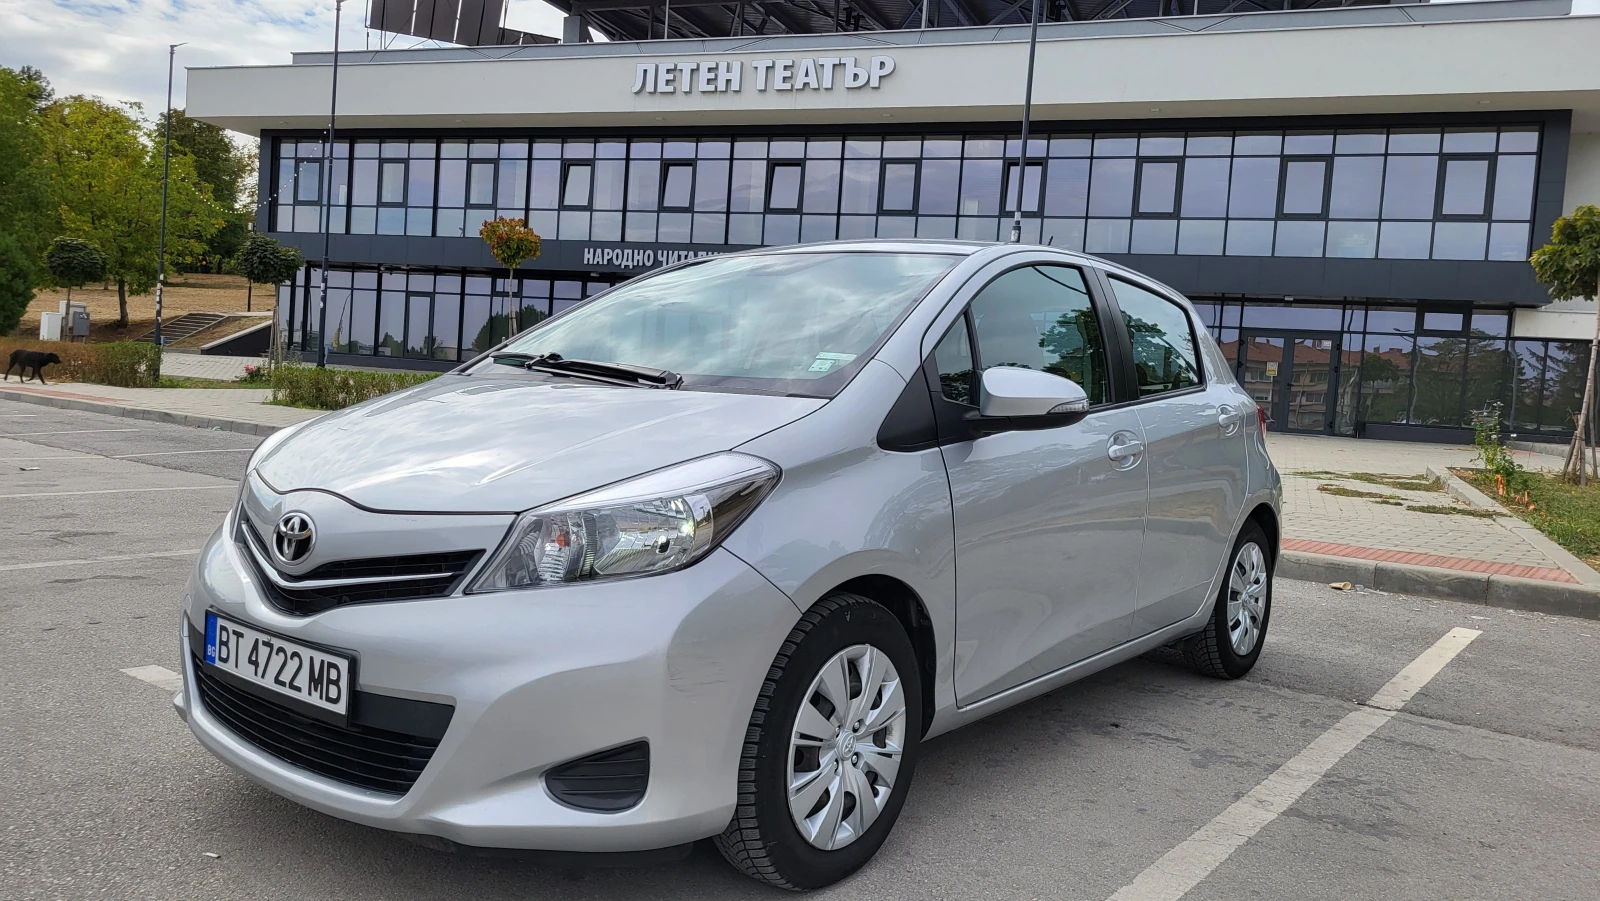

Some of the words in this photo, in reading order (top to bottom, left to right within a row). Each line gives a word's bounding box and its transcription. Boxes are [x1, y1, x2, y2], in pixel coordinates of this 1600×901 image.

[631, 60, 744, 94] ЛЕТЕН
[752, 55, 896, 92] ТЕАТЪР
[583, 248, 654, 269] НАРОДНО
[207, 644, 216, 657] BG
[218, 624, 244, 669] BT
[248, 637, 303, 693] 4722
[308, 655, 342, 705] MB
